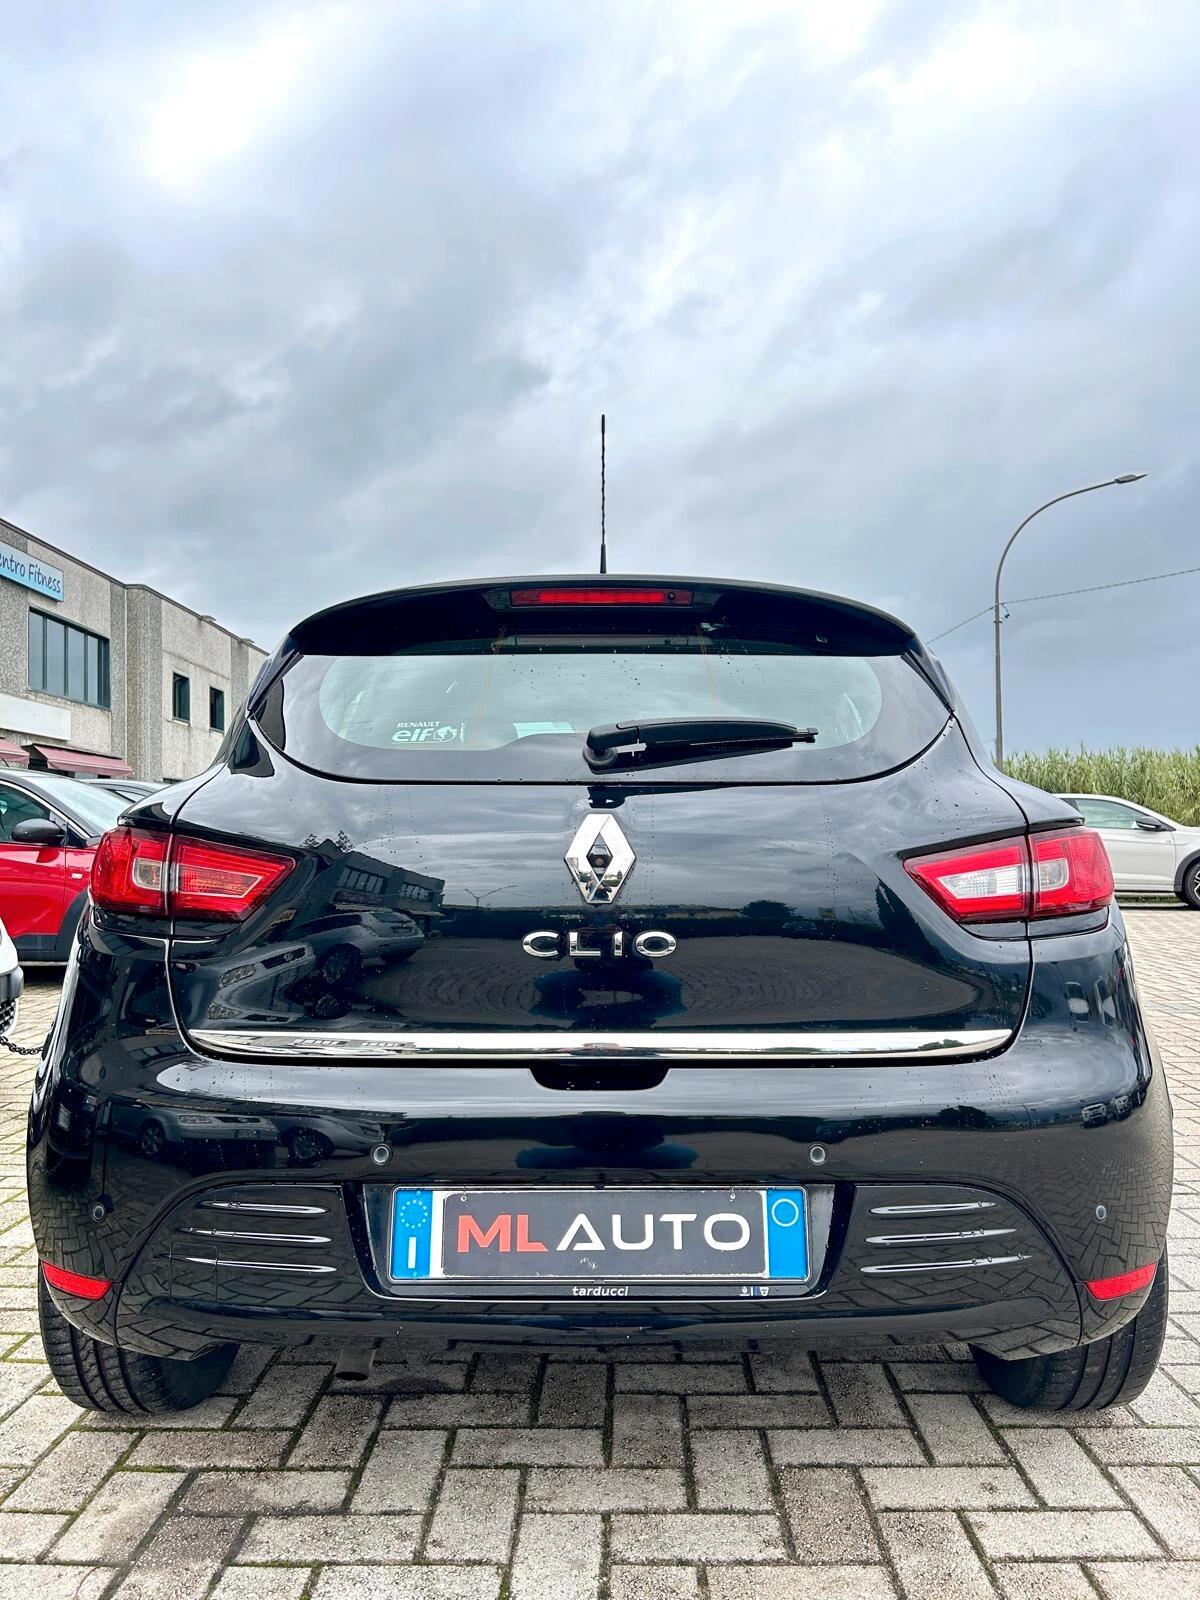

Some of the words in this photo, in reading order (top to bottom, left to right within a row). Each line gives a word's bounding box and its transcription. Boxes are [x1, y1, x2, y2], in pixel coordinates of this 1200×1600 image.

[28, 563, 61, 593] Fitness
[397, 721, 440, 729] RENAULT
[522, 930, 678, 958] CLIO
[571, 1286, 629, 1297] tarducci
